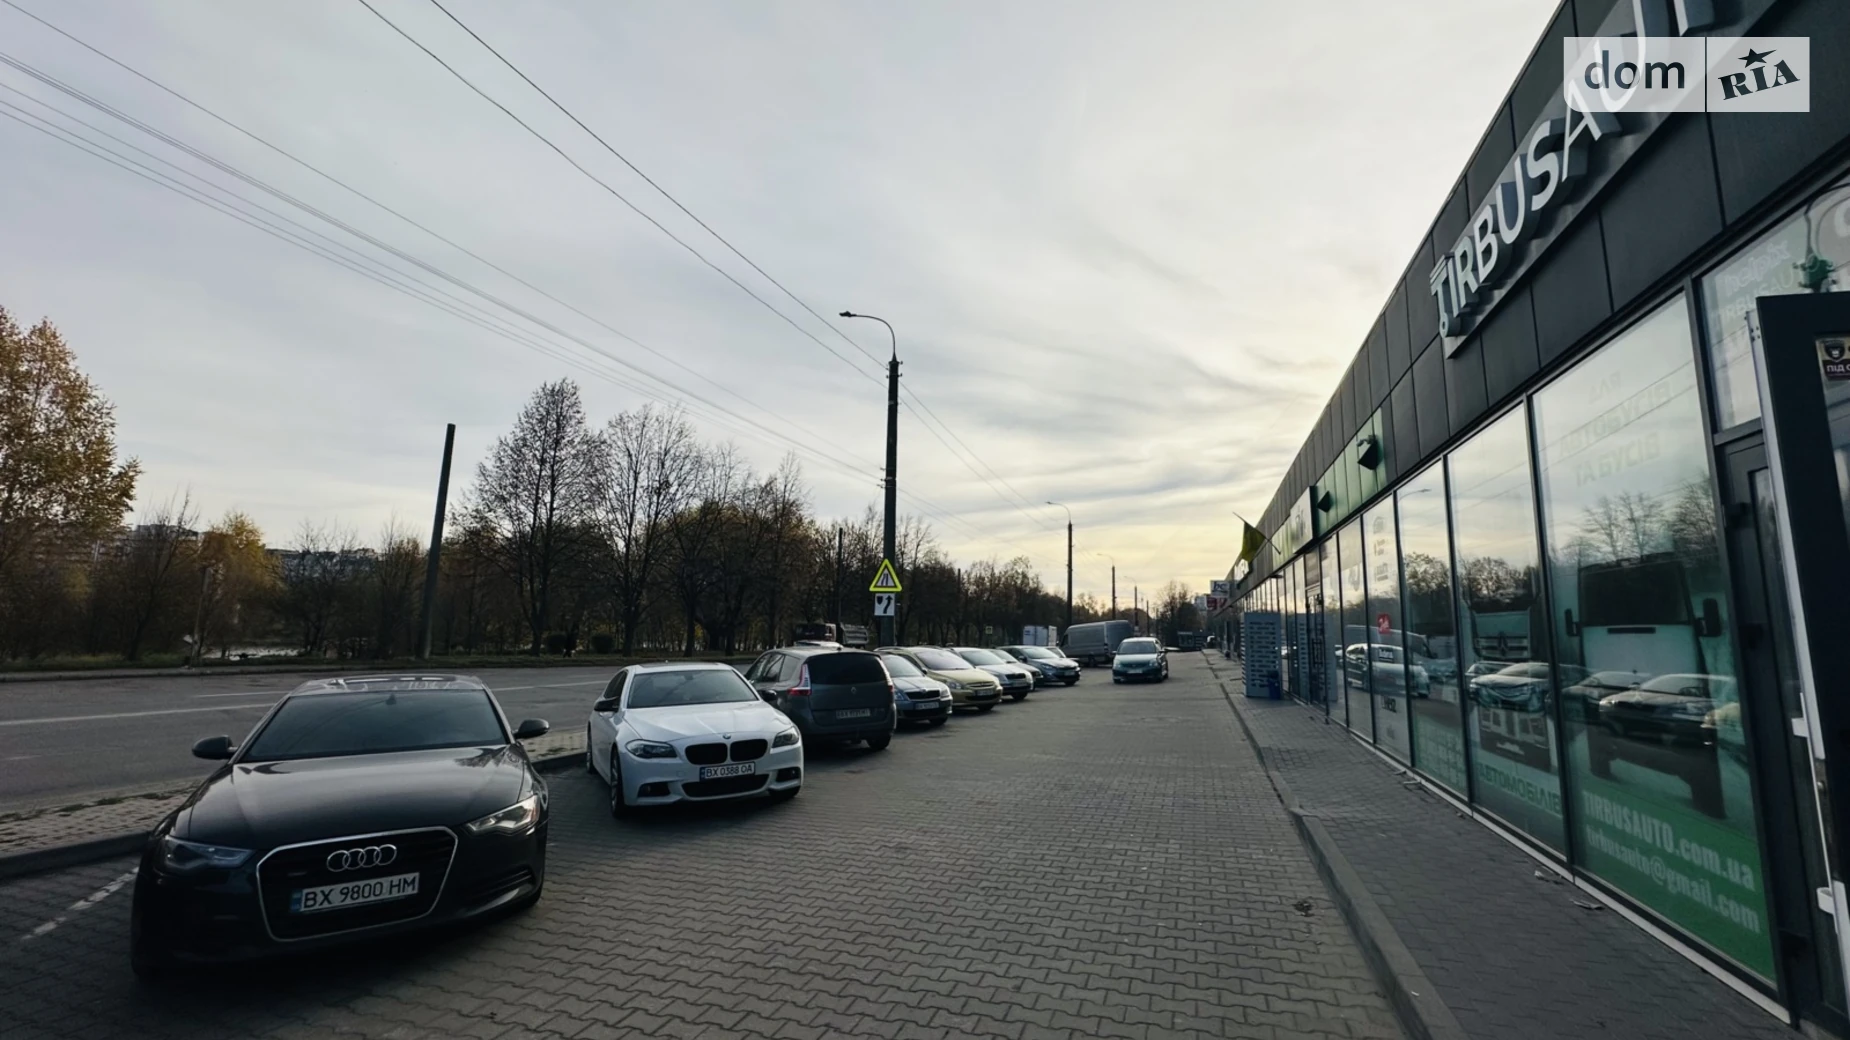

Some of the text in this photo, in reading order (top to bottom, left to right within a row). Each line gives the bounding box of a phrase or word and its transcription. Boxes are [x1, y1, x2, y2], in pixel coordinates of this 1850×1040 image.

[304, 888, 334, 908] BX
[340, 881, 384, 903] 9800
[389, 876, 416, 895] HM
[1582, 789, 1756, 892] TIRBUSAUTO.com.ua
[1586, 824, 1760, 933] tirbusauto@gmail.com
